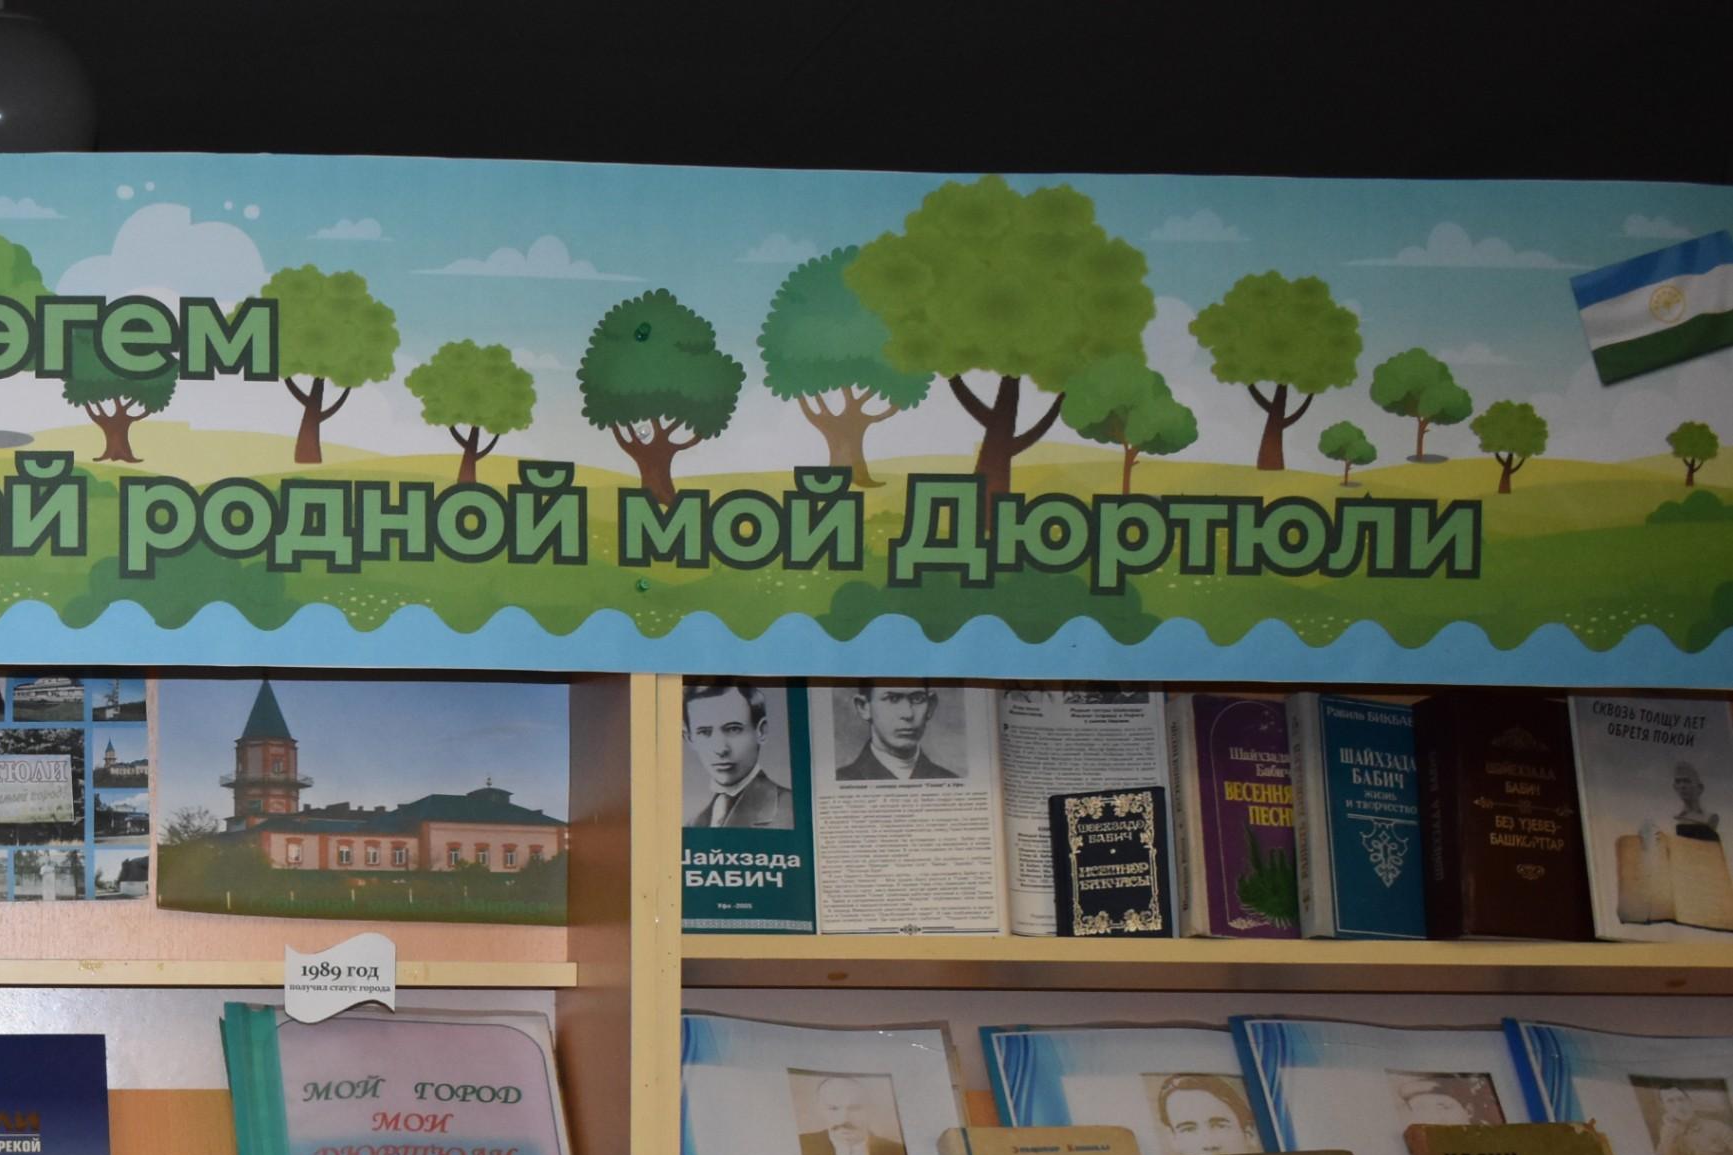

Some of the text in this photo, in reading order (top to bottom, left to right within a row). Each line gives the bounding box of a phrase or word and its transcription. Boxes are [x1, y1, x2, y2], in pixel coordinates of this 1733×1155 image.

[119, 460, 586, 580] родной
[618, 465, 867, 572] мой
[888, 473, 1481, 596] Дюртюли
[1326, 706, 1365, 722] Равиль
[1592, 701, 1706, 729] СКВОЗЬ ТОЛЩУ ЛЕТ
[1607, 724, 1651, 742] ОБРЕТЯ
[1340, 746, 1418, 773] ШАЙХЗАДА
[1352, 768, 1404, 790] БАБИЧ
[1345, 800, 1354, 809] и
[1088, 832, 1133, 844] БАБИЧ
[684, 870, 784, 889] БАБИЧ
[301, 962, 379, 980] 1989 год
[289, 984, 391, 993] получил статус города
[302, 1075, 523, 1105] МОЙ ГОРОД
